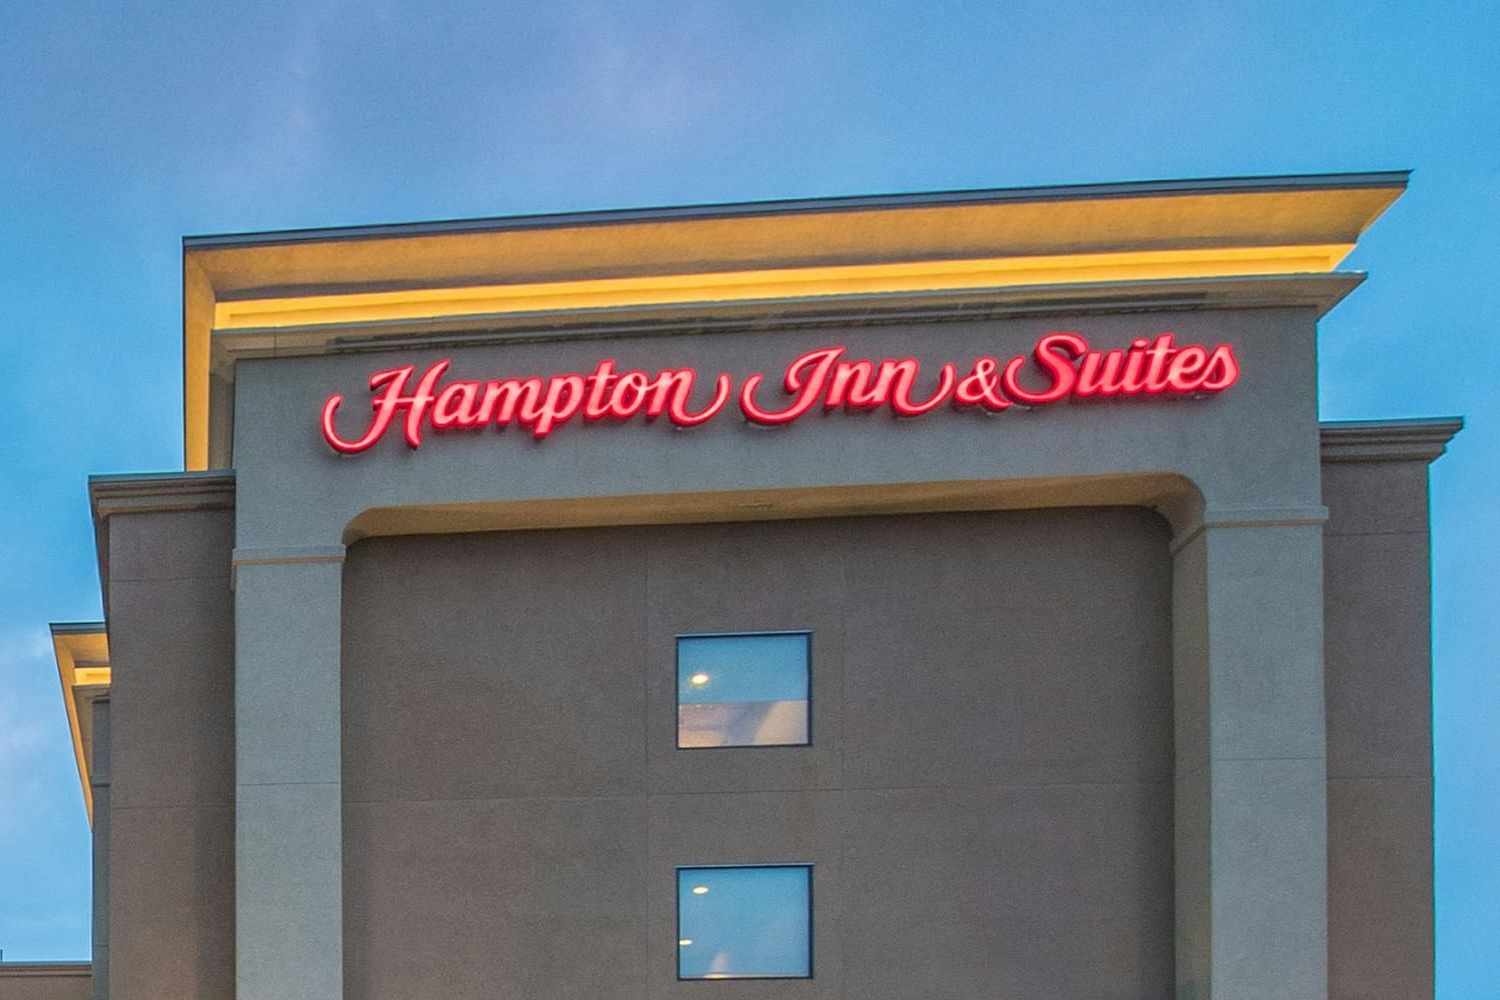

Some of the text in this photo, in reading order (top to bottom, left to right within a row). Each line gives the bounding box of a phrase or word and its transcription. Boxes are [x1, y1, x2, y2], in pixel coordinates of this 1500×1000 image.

[322, 333, 1239, 454] Hampton Inn & Suites
